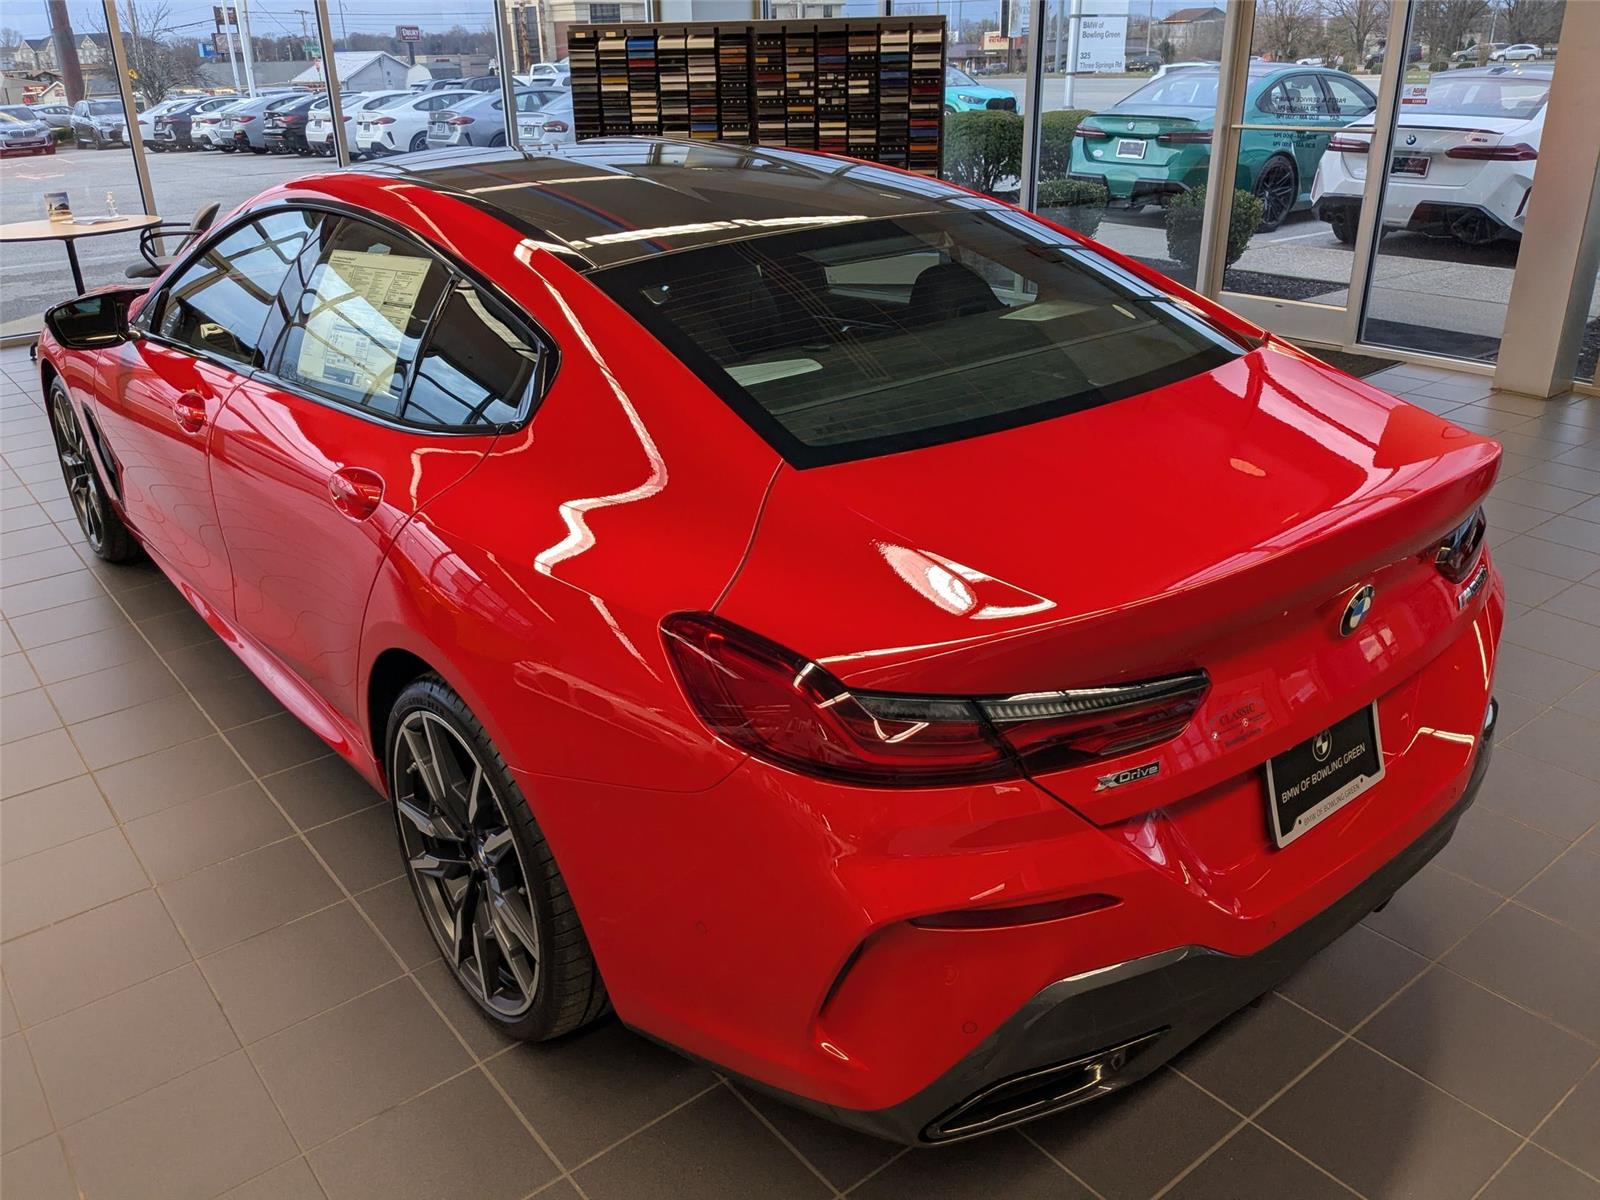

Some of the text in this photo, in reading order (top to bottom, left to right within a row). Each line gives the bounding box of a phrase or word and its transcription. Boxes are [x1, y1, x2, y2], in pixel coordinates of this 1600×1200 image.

[1083, 21, 1098, 29] BMW
[1082, 31, 1104, 39] Bowling
[1080, 52, 1091, 60] 325
[1281, 742, 1366, 804] BMW OF BOWLING GREEN
[1303, 783, 1361, 826] BMW OF BOWLING GREEN
